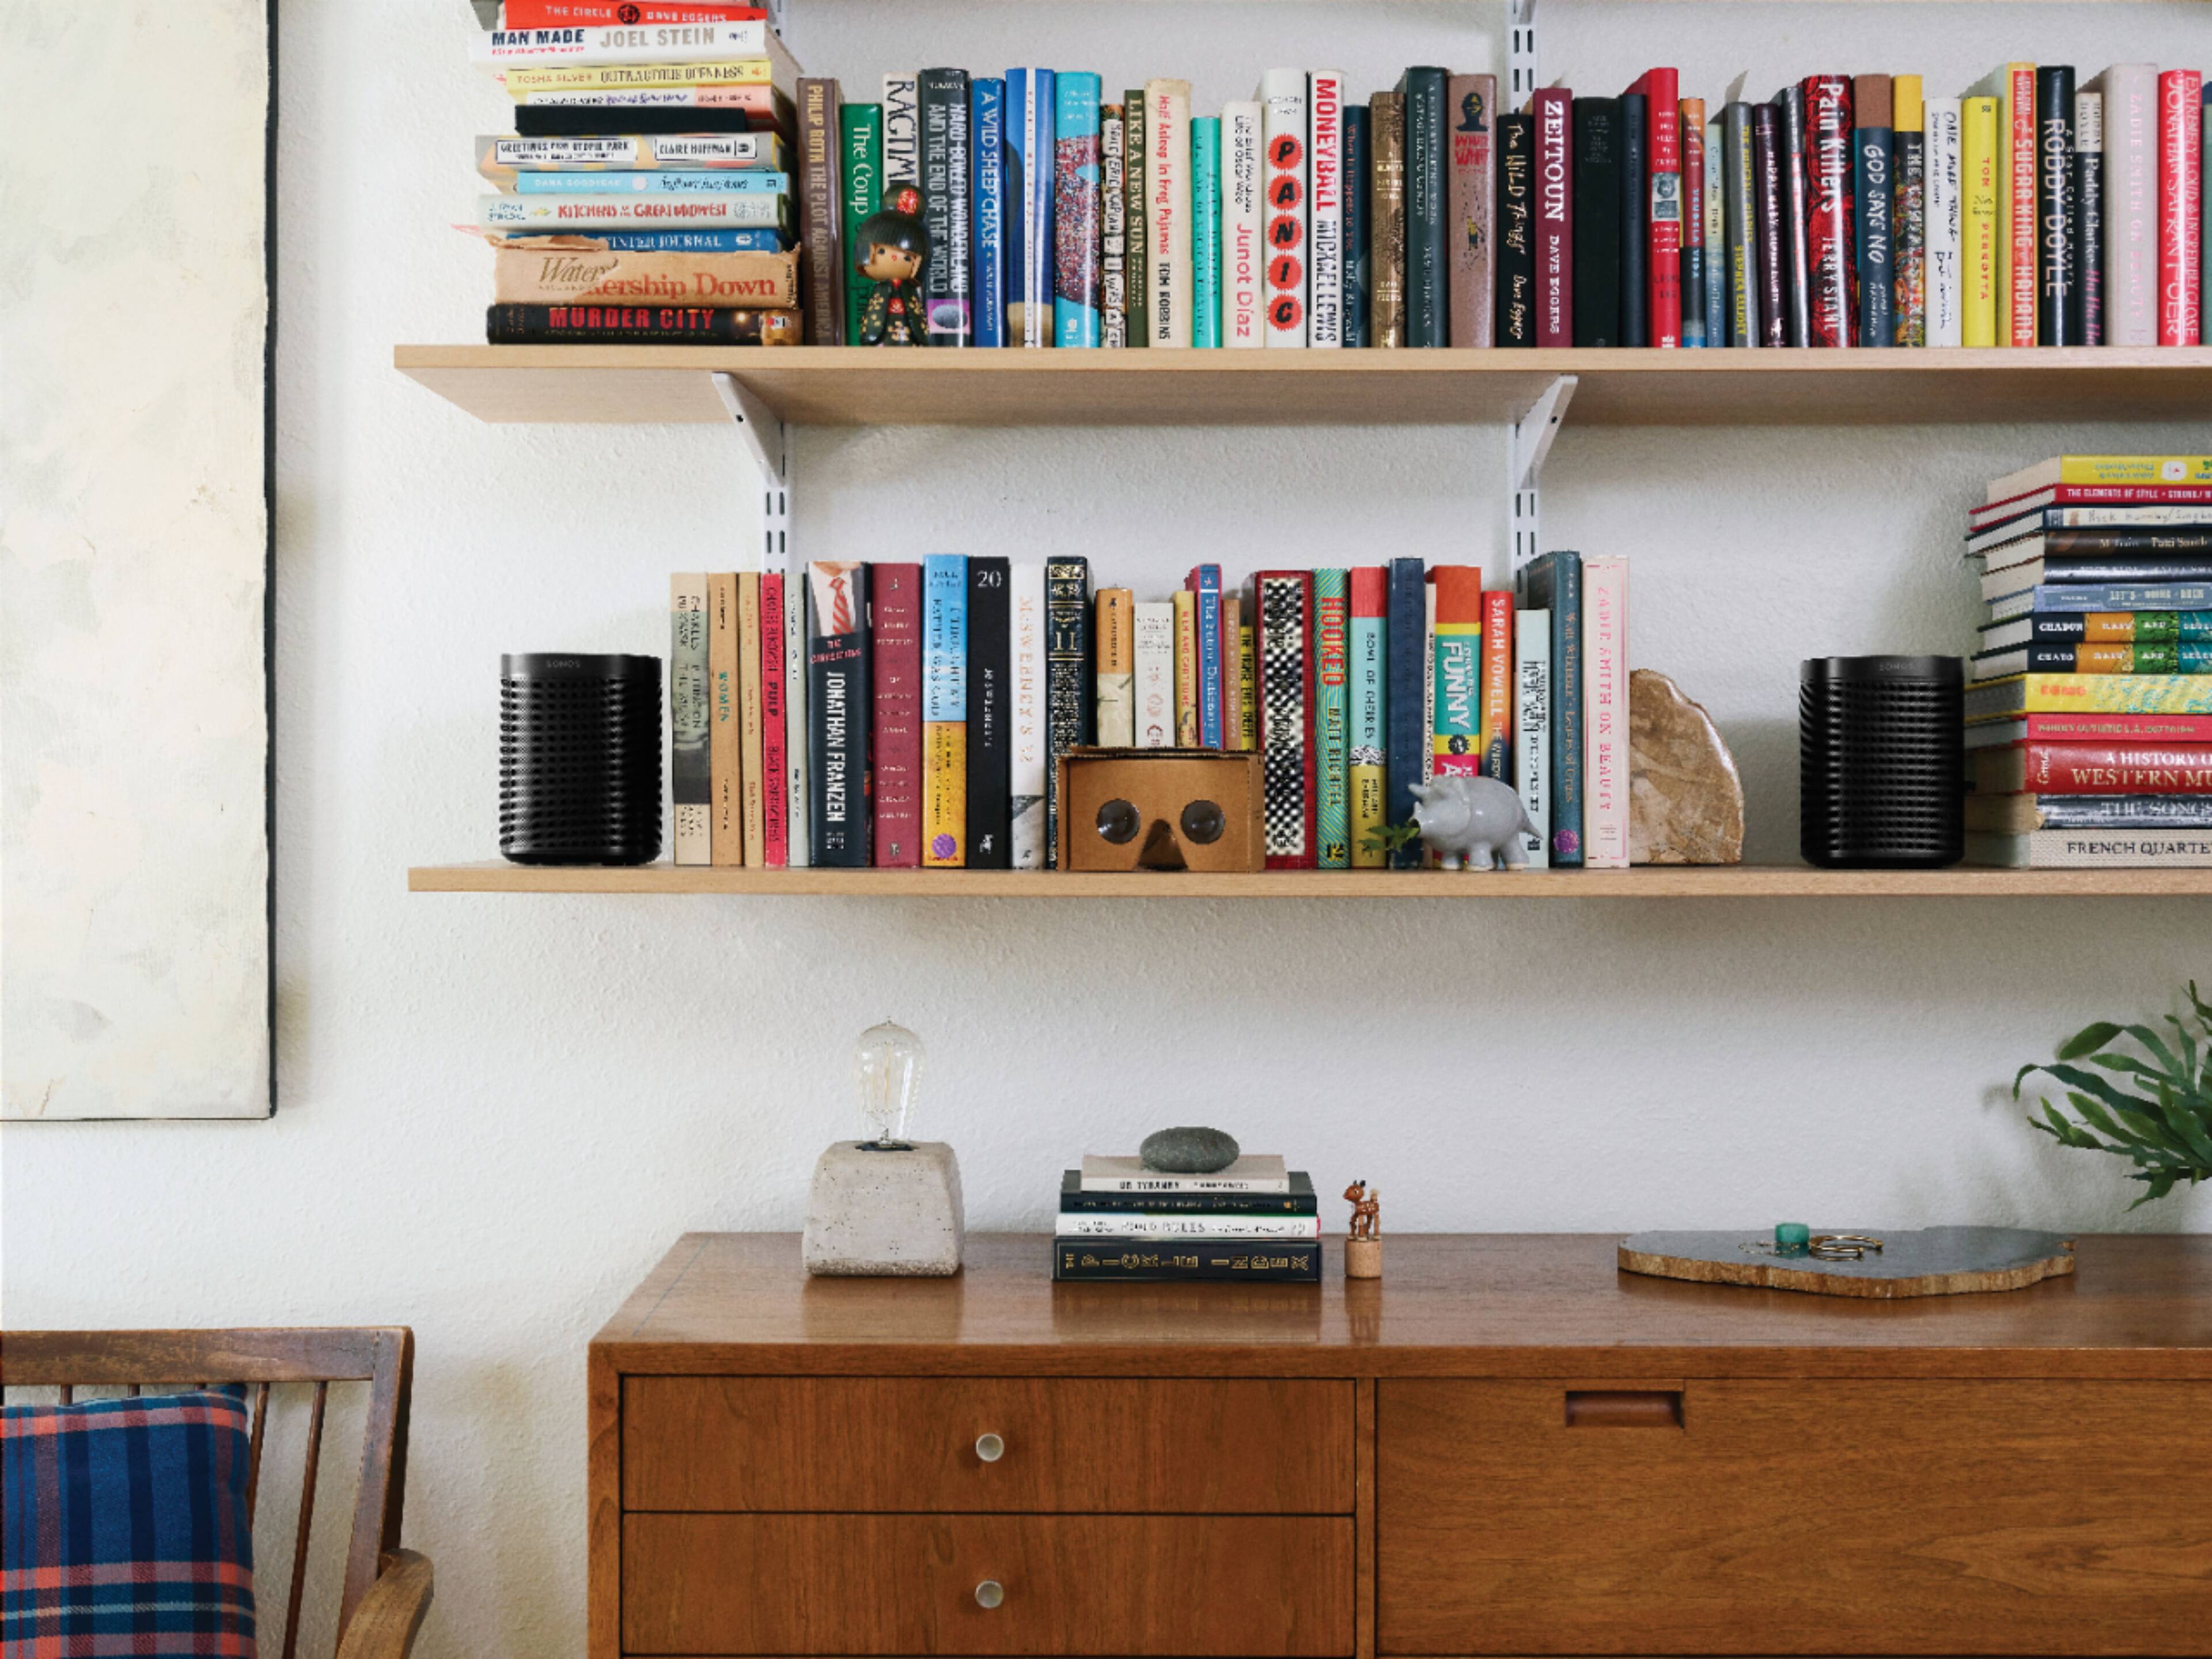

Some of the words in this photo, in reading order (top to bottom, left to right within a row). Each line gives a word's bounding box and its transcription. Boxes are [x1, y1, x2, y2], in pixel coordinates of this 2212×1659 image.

[547, 6, 568, 16] THE
[492, 31, 529, 46] MAN
[536, 29, 585, 45] MADE
[600, 30, 649, 48] JOEL
[657, 27, 715, 46] STEIN
[808, 86, 824, 126] PHILIP
[982, 92, 995, 104] A
[1819, 83, 1844, 131] Pain
[982, 108, 996, 145] WILD
[1128, 99, 1142, 145] LIKE
[1508, 123, 1524, 149] The
[2130, 93, 2142, 147] ZADIE
[809, 129, 824, 162] ROTH
[853, 124, 870, 158] The
[929, 135, 945, 161] THE
[1129, 149, 1142, 161] A
[1316, 79, 1336, 211] MONEYBALL
[1544, 100, 1564, 221] ZEITOUN
[810, 166, 825, 188] THE
[929, 164, 946, 190] END
[982, 150, 997, 194] SHEEP
[1820, 138, 1846, 213] Killers
[1863, 145, 1885, 184] GOD
[1981, 157, 1990, 188] TOM
[2014, 139, 2033, 199] SUGAR
[2044, 118, 2066, 205] RODDY
[2081, 157, 2099, 203] Paddy
[850, 164, 872, 214] Coup
[1129, 166, 1144, 210] NEW
[2130, 154, 2142, 211] SMITH
[811, 193, 827, 223] PLOT
[982, 198, 997, 248] CHASE
[1866, 190, 1885, 230] SAYS
[2015, 205, 2033, 246] KING
[660, 234, 722, 248] JOURNAL
[1130, 216, 1145, 253] SUN
[1236, 224, 1253, 283] Junot
[1549, 235, 1559, 273] DAVE
[1867, 234, 1885, 263] NO
[2045, 214, 2067, 298] DOYLE
[692, 272, 778, 297] Down
[2015, 265, 2033, 340] HAVANA
[548, 308, 654, 328] MURDER
[660, 308, 715, 329] CITY
[1236, 291, 1253, 337] Díaz
[2185, 291, 2199, 336] CLOSE
[977, 570, 1002, 588] 20
[1491, 599, 1505, 649] SARAH
[1597, 586, 1611, 640] ZADIE
[1320, 597, 1344, 686] HOOKED
[1442, 641, 1469, 729] FUNNY
[1491, 654, 1505, 717] VOWELL
[1599, 647, 1612, 704] SMITH
[718, 672, 729, 722] WOMEN
[827, 671, 844, 748] JONATHAN
[1328, 707, 1340, 741] MATT
[1492, 721, 1502, 740] THE
[1599, 711, 1612, 734] ON
[1599, 743, 1612, 811] BEAUTY
[2070, 768, 2179, 785] WESTERN
[2107, 752, 2115, 765] A
[2121, 752, 2196, 766] HISTORY
[827, 751, 845, 822] FRANZEN
[2067, 842, 2135, 855] FRENCH
[2140, 841, 2212, 857] QUARTE
